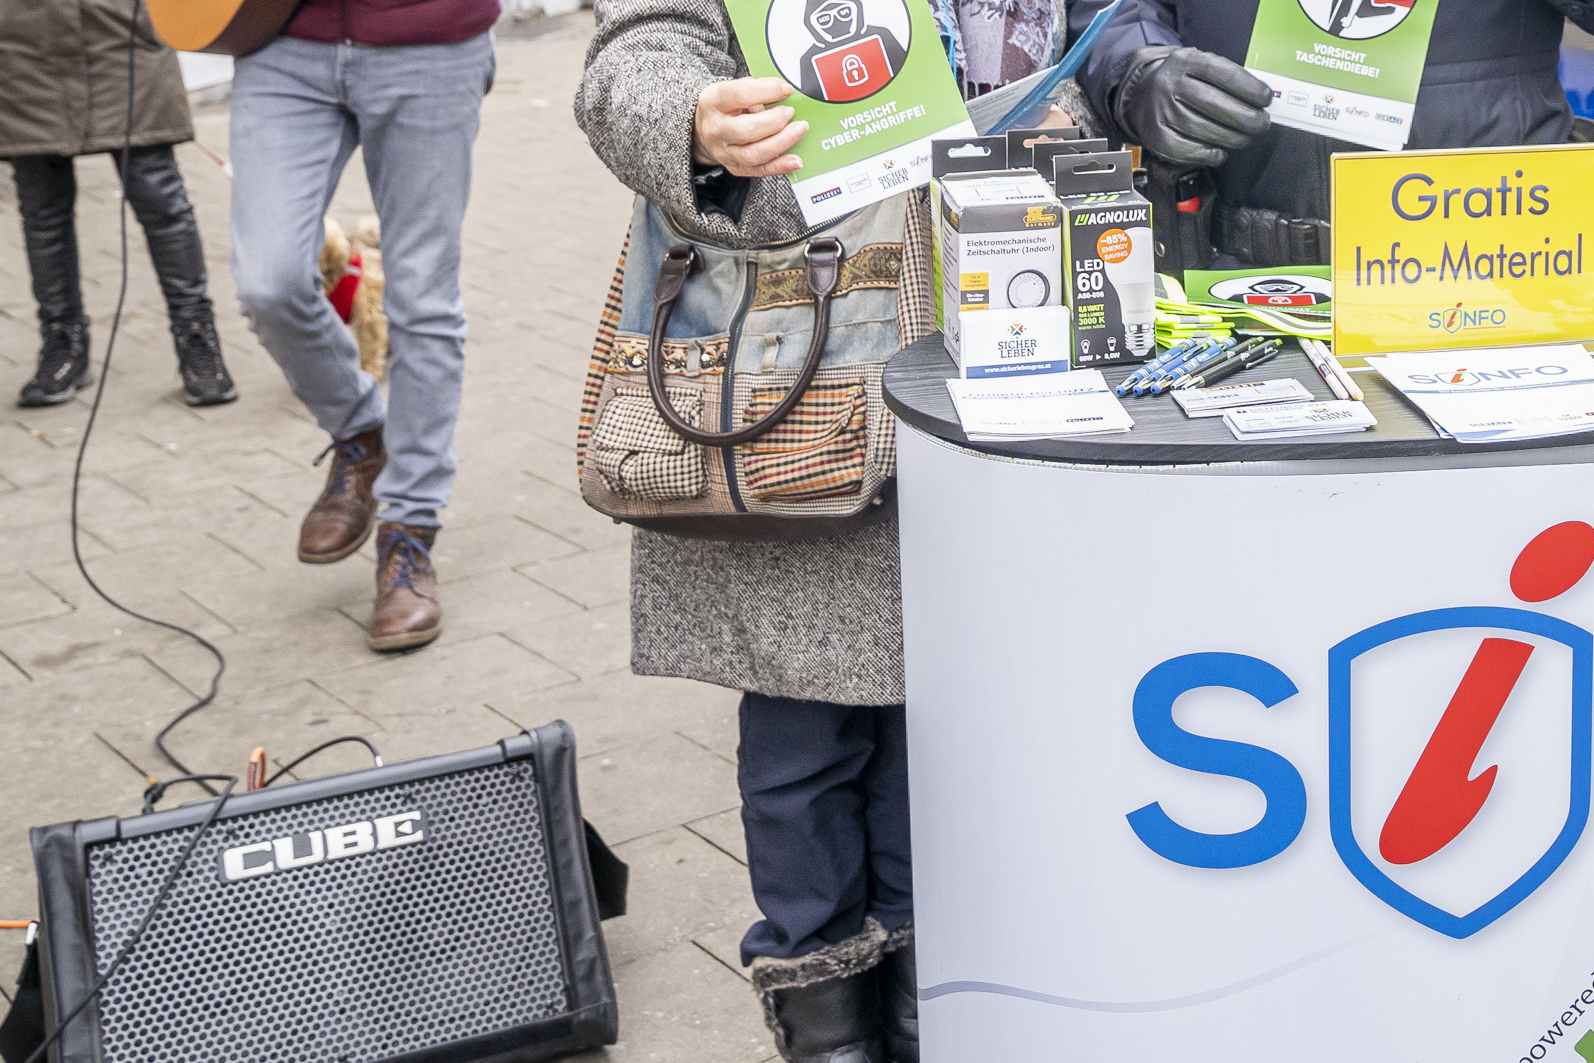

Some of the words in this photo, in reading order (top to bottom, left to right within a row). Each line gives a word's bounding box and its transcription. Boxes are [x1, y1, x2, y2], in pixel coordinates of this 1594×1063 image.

[1314, 42, 1366, 63] VORSICHT
[1295, 50, 1380, 78] TASCHENDIEBE!
[840, 101, 897, 130] VORSICHT
[821, 104, 926, 150] CYBER-ANGRIFFE!
[878, 168, 909, 184] SICHER
[881, 176, 910, 190] LEBEN
[812, 189, 840, 203] POLIZEI
[1391, 169, 1550, 222] Gratis
[966, 236, 1047, 247] Elektromechanische
[1101, 243, 1128, 254] ENERGY
[966, 247, 1020, 256] Zeitschaltuhr
[1021, 244, 1055, 254] (Indoor)
[1104, 250, 1128, 260] SAVING
[1076, 258, 1104, 272] LED
[1356, 233, 1583, 286] Info-Material
[1077, 271, 1104, 292] 60
[1078, 317, 1097, 325] 3000
[997, 339, 1037, 350] SICHER
[1000, 348, 1035, 359] LEBEN
[224, 809, 424, 881] CUBE
